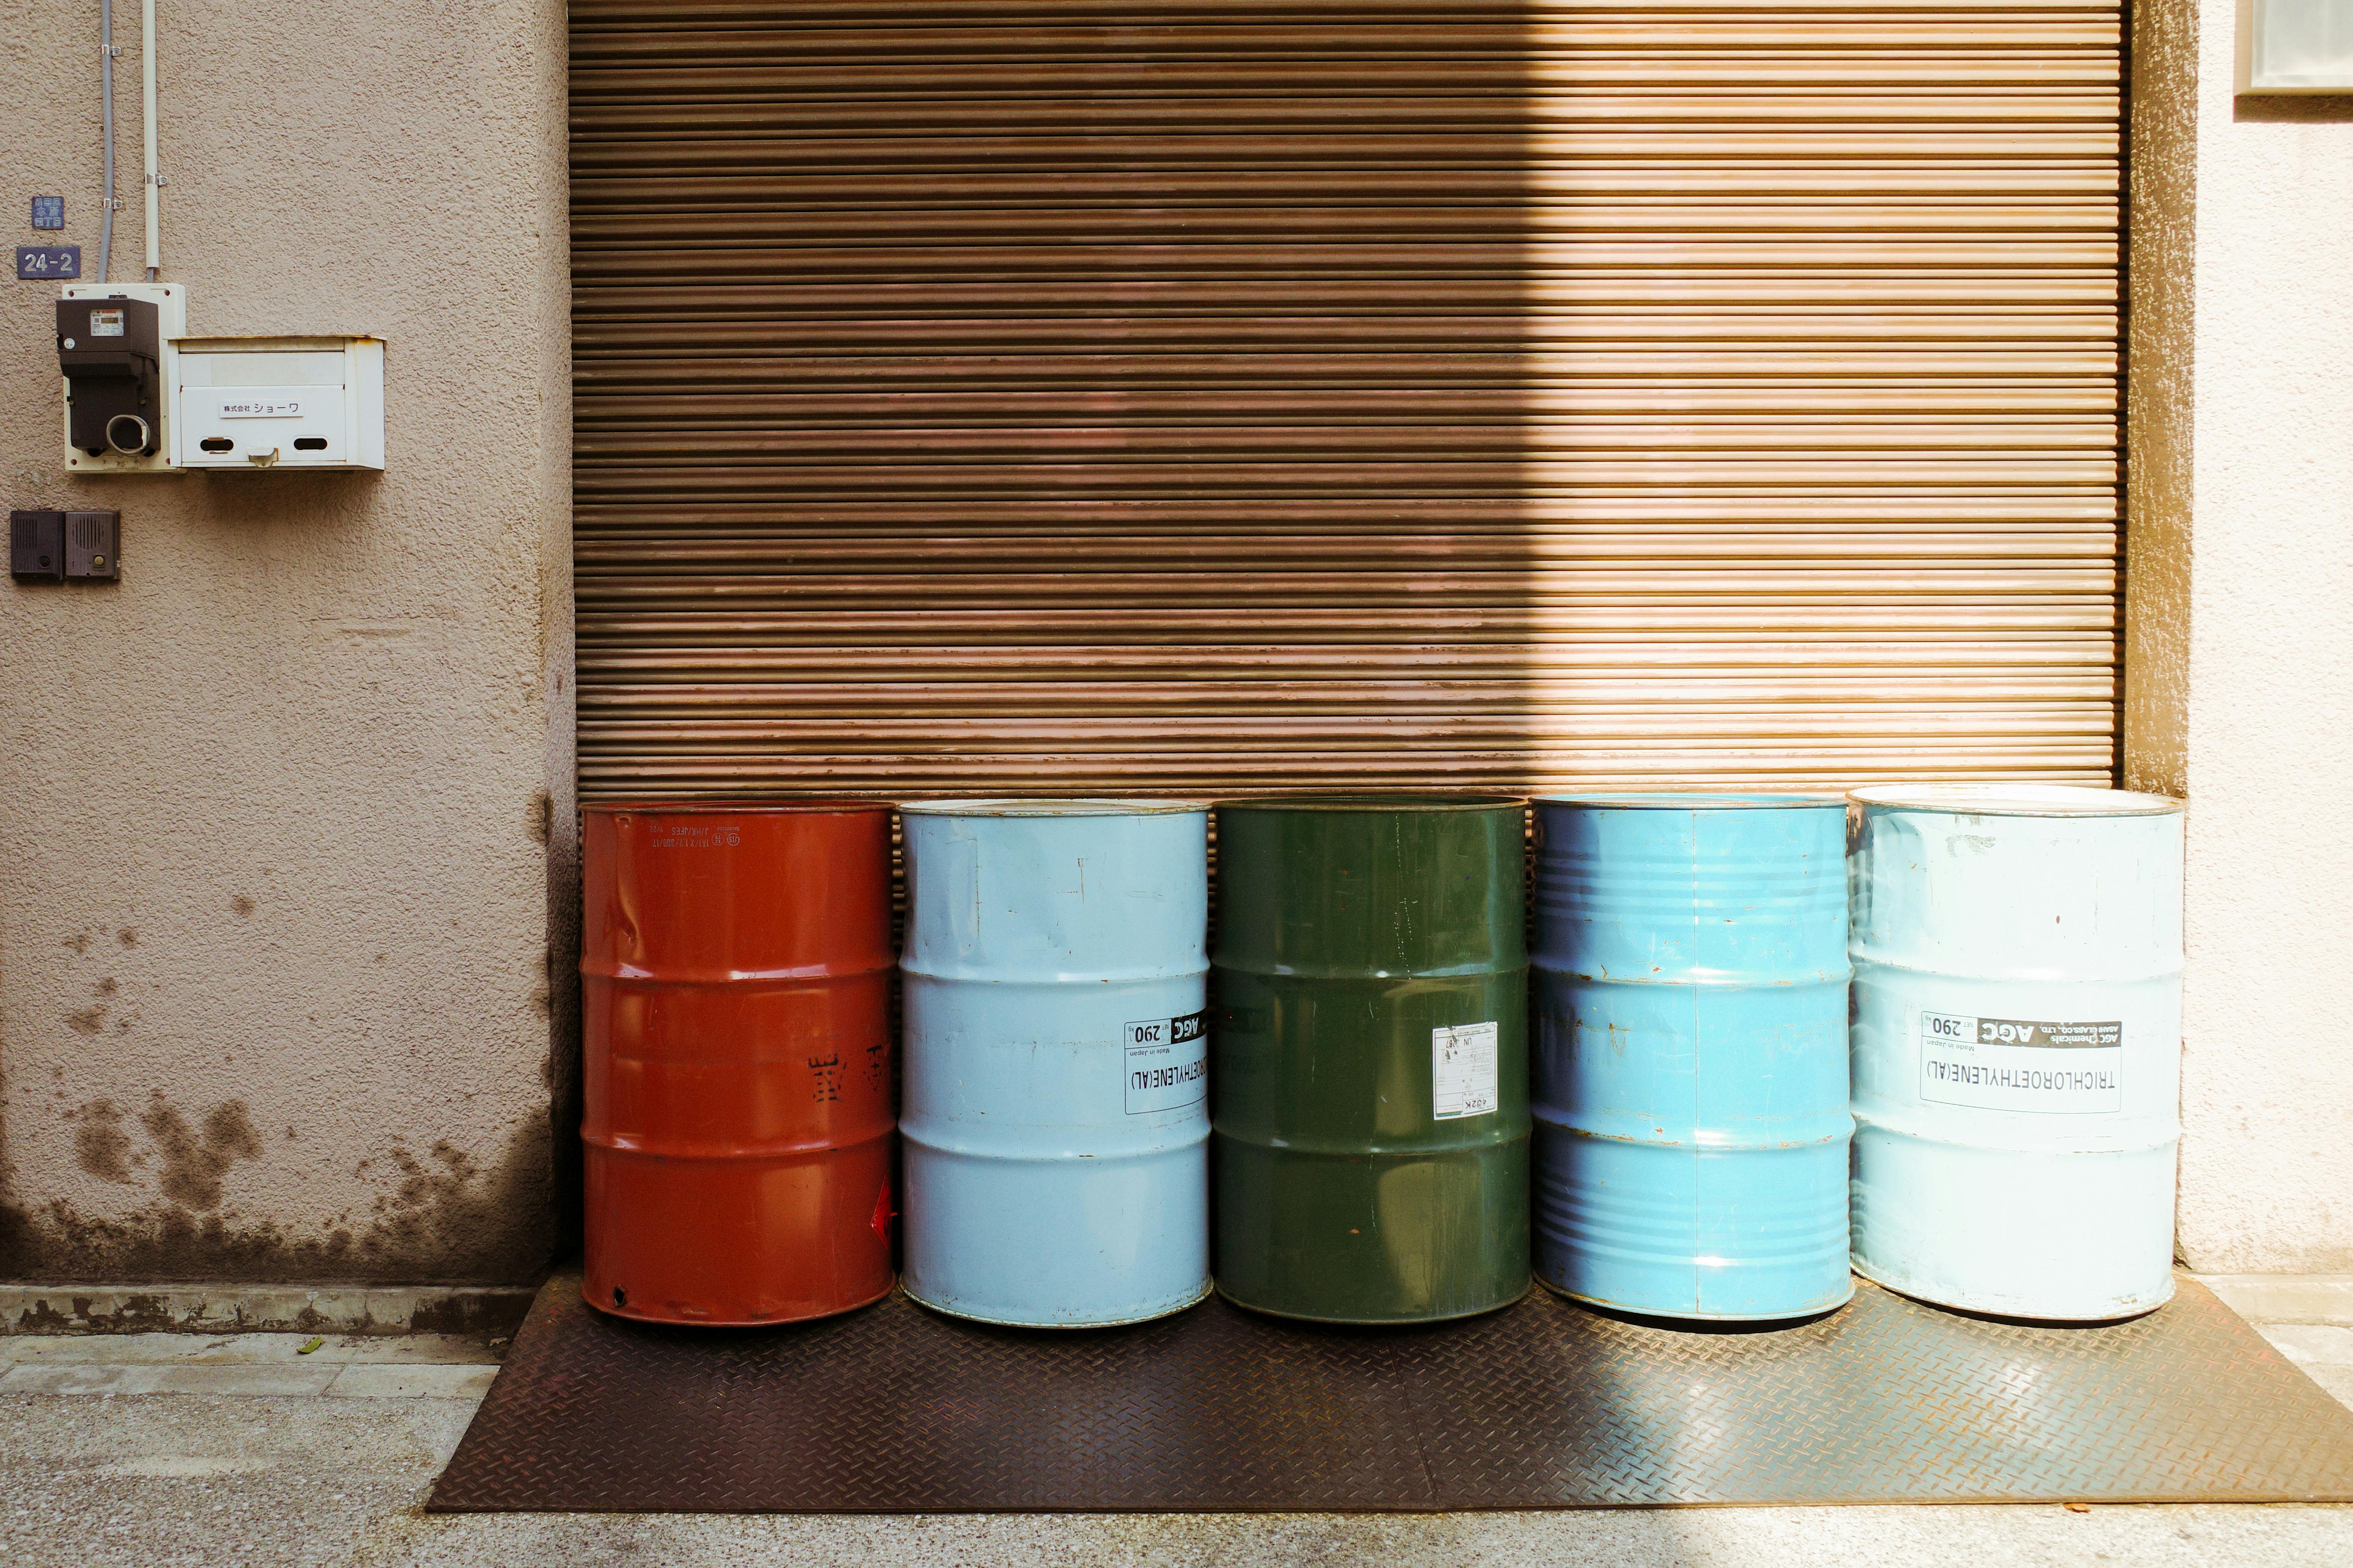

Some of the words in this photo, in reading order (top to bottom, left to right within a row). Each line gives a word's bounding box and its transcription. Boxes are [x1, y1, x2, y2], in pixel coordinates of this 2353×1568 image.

[24, 253, 73, 272] 24-2
[728, 835, 740, 844] JIS
[1174, 1016, 1199, 1038] AGC
[1933, 1018, 1961, 1037] 290
[1135, 1025, 1160, 1043] 290
[1981, 1023, 2035, 1043] AGC
[1446, 1038, 1460, 1048] 67
[1464, 1038, 1472, 1046] UN
[2050, 1035, 2098, 1044] Chemicals
[2099, 1034, 2118, 1043] AGC
[1927, 1040, 1946, 1048] Japan
[1956, 1043, 1975, 1052] Made
[1927, 1060, 2115, 1090] TRICHLOROETHYLENE(AL)
